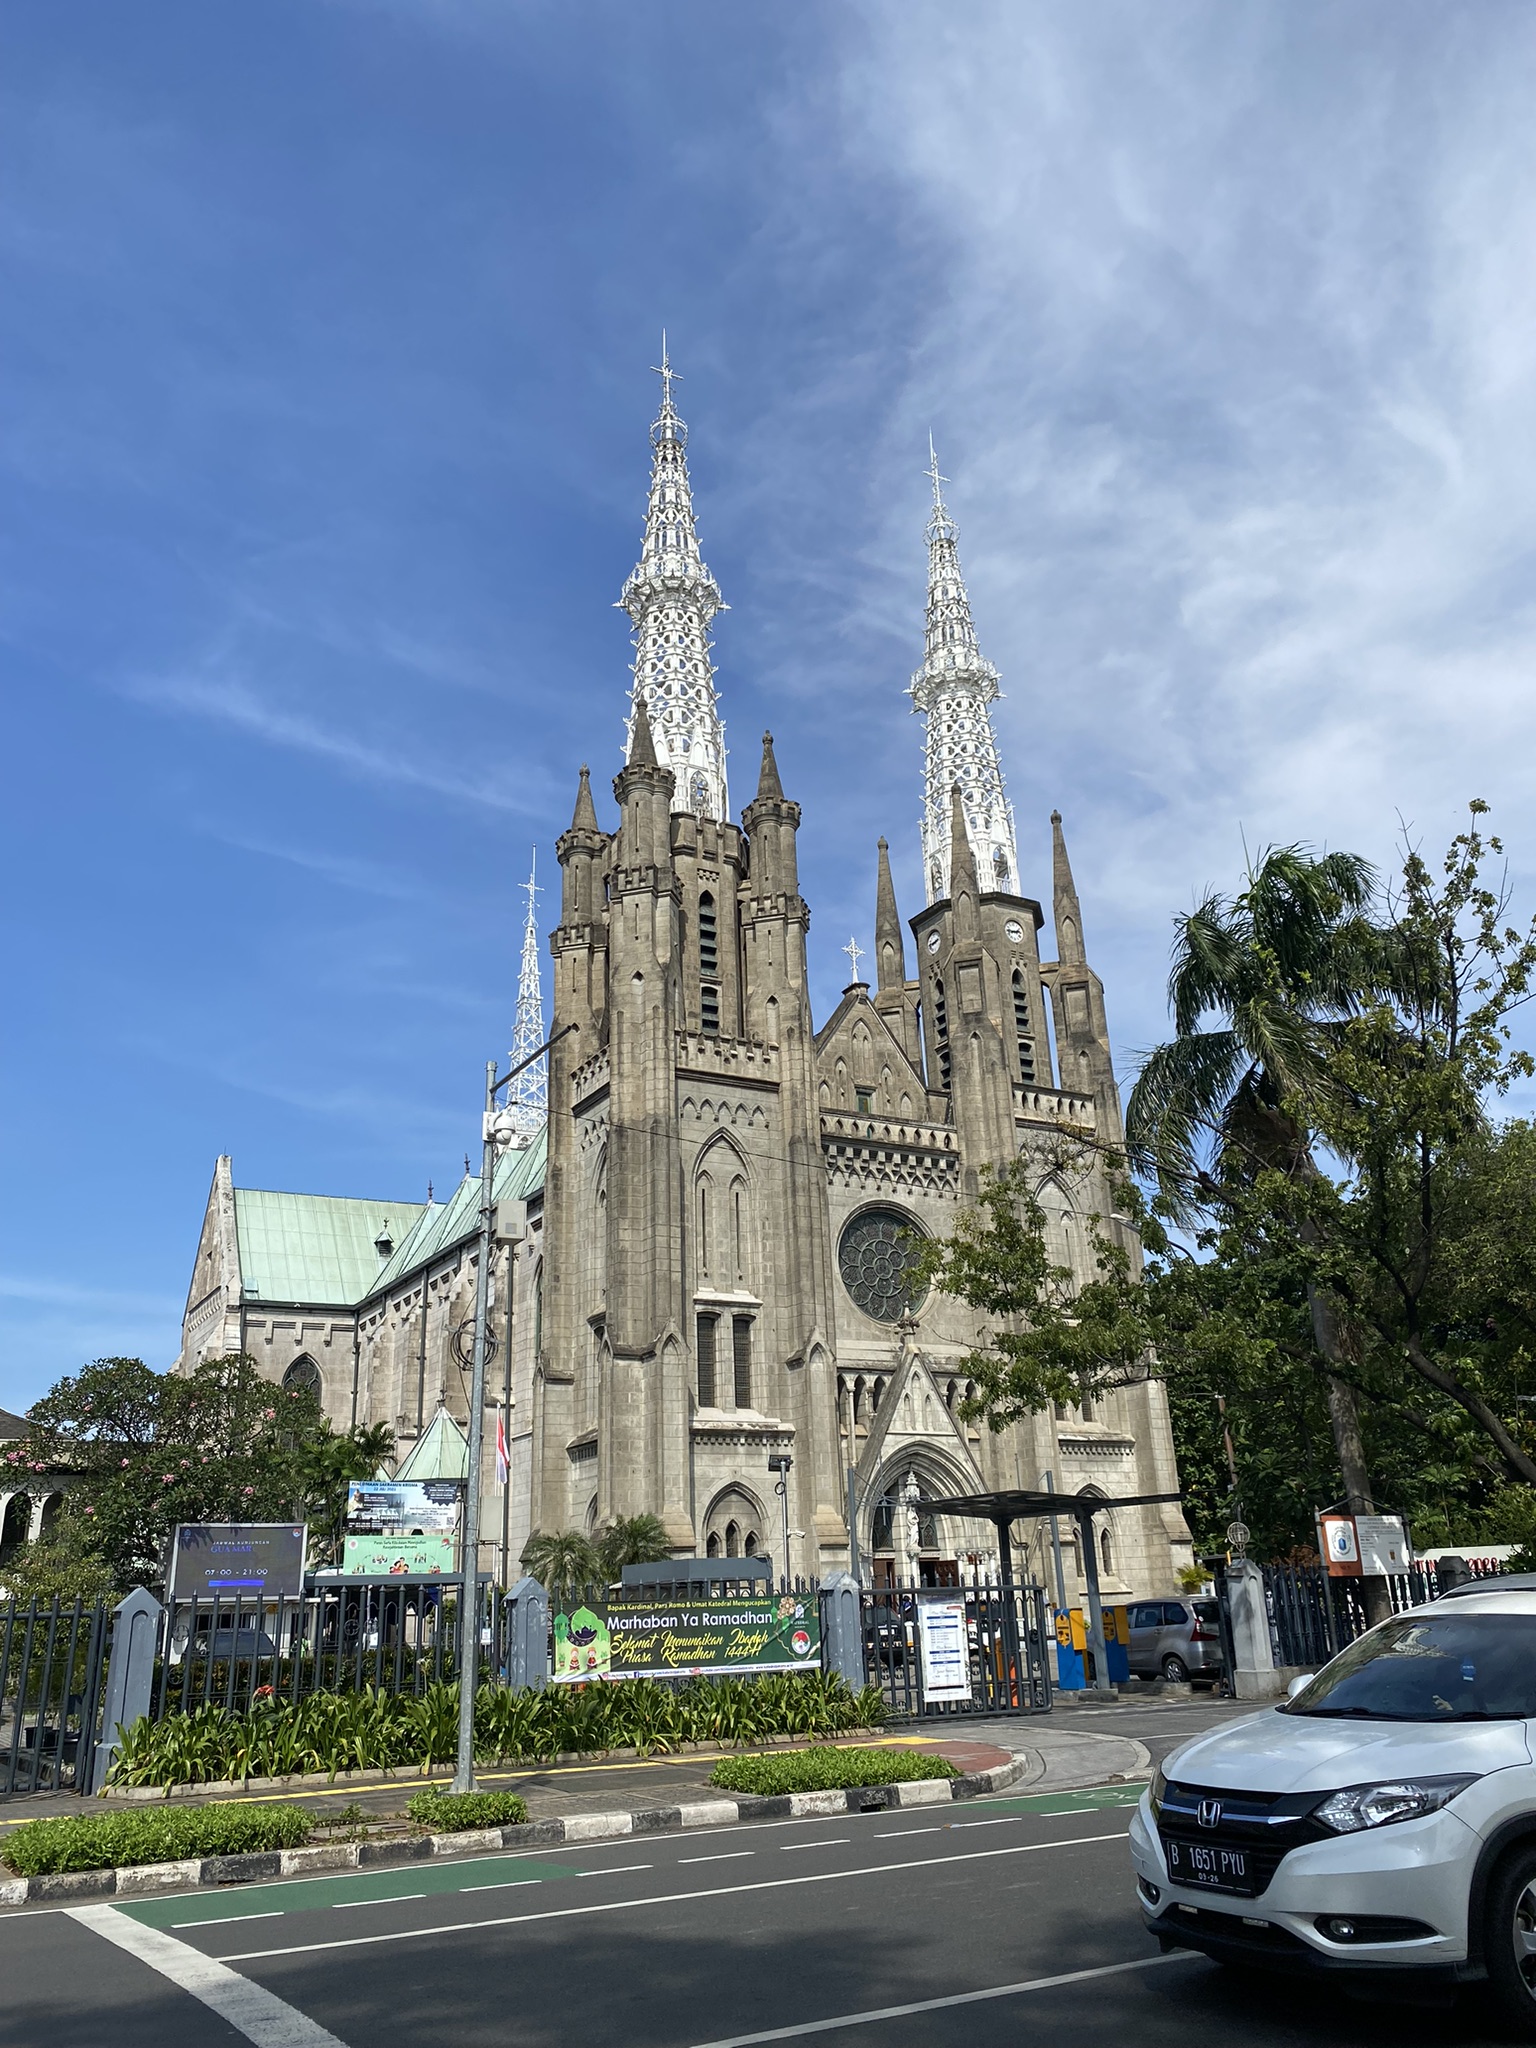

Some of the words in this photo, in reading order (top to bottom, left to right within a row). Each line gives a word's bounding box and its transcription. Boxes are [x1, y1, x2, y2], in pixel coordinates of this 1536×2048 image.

[210, 1545, 230, 1553] GUA
[242, 1568, 268, 1576] 21:00
[607, 1604, 626, 1612] Bapak
[668, 1601, 685, 1609] Romo
[732, 1600, 772, 1608] Mengucapkan
[606, 1614, 678, 1630] Marhaban
[681, 1613, 698, 1627] Ya
[702, 1611, 772, 1626] Ramadhan
[610, 1631, 659, 1654] Selamat
[660, 1629, 724, 1649] Menunaikan
[728, 1628, 769, 1646] Ibadah
[620, 1647, 654, 1664] Puasa
[660, 1645, 716, 1668] Ramadhan
[724, 1644, 762, 1658] 1444H
[1171, 1844, 1179, 1865] B
[1189, 1847, 1216, 1871] 1651
[1221, 1851, 1245, 1876] PYU
